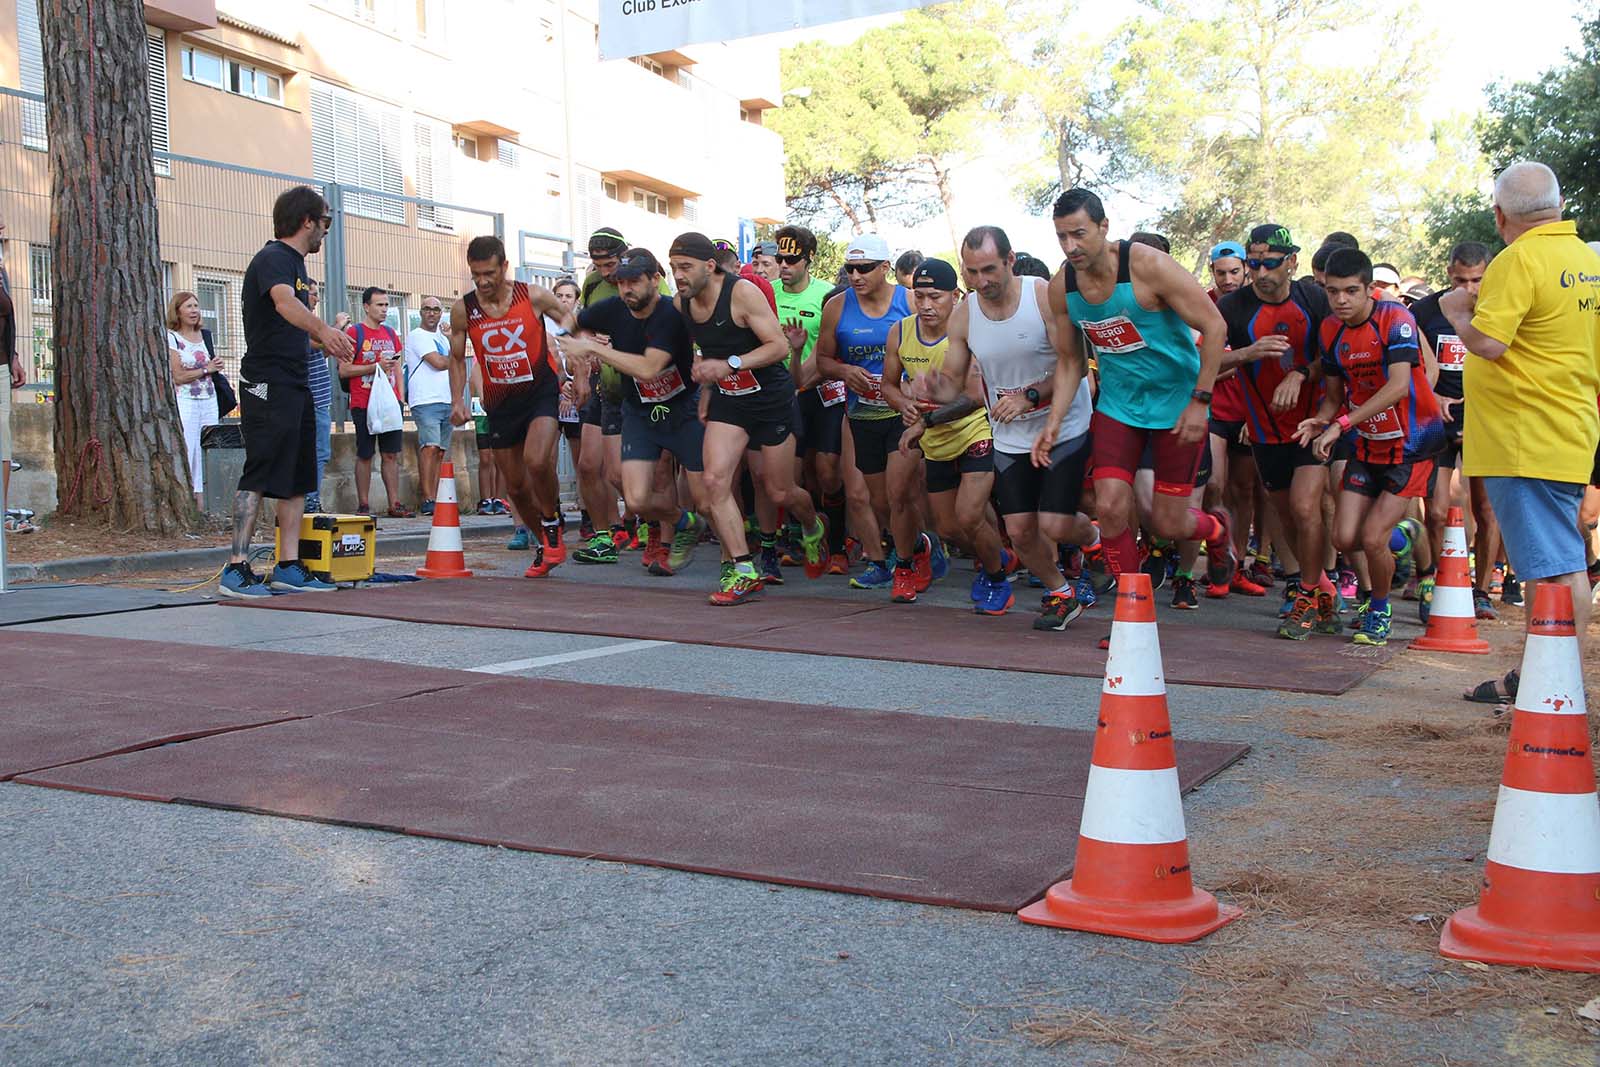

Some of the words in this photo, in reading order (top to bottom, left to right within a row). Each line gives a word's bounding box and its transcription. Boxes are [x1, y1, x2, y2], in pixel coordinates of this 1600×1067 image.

[622, 0, 656, 15] Club
[1096, 325, 1126, 339] SERGI
[481, 324, 527, 353] CX
[1107, 336, 1125, 347] 11
[497, 361, 519, 370] JULIO
[504, 370, 516, 378] 19
[731, 382, 739, 390] 2
[1369, 424, 1378, 433] 3
